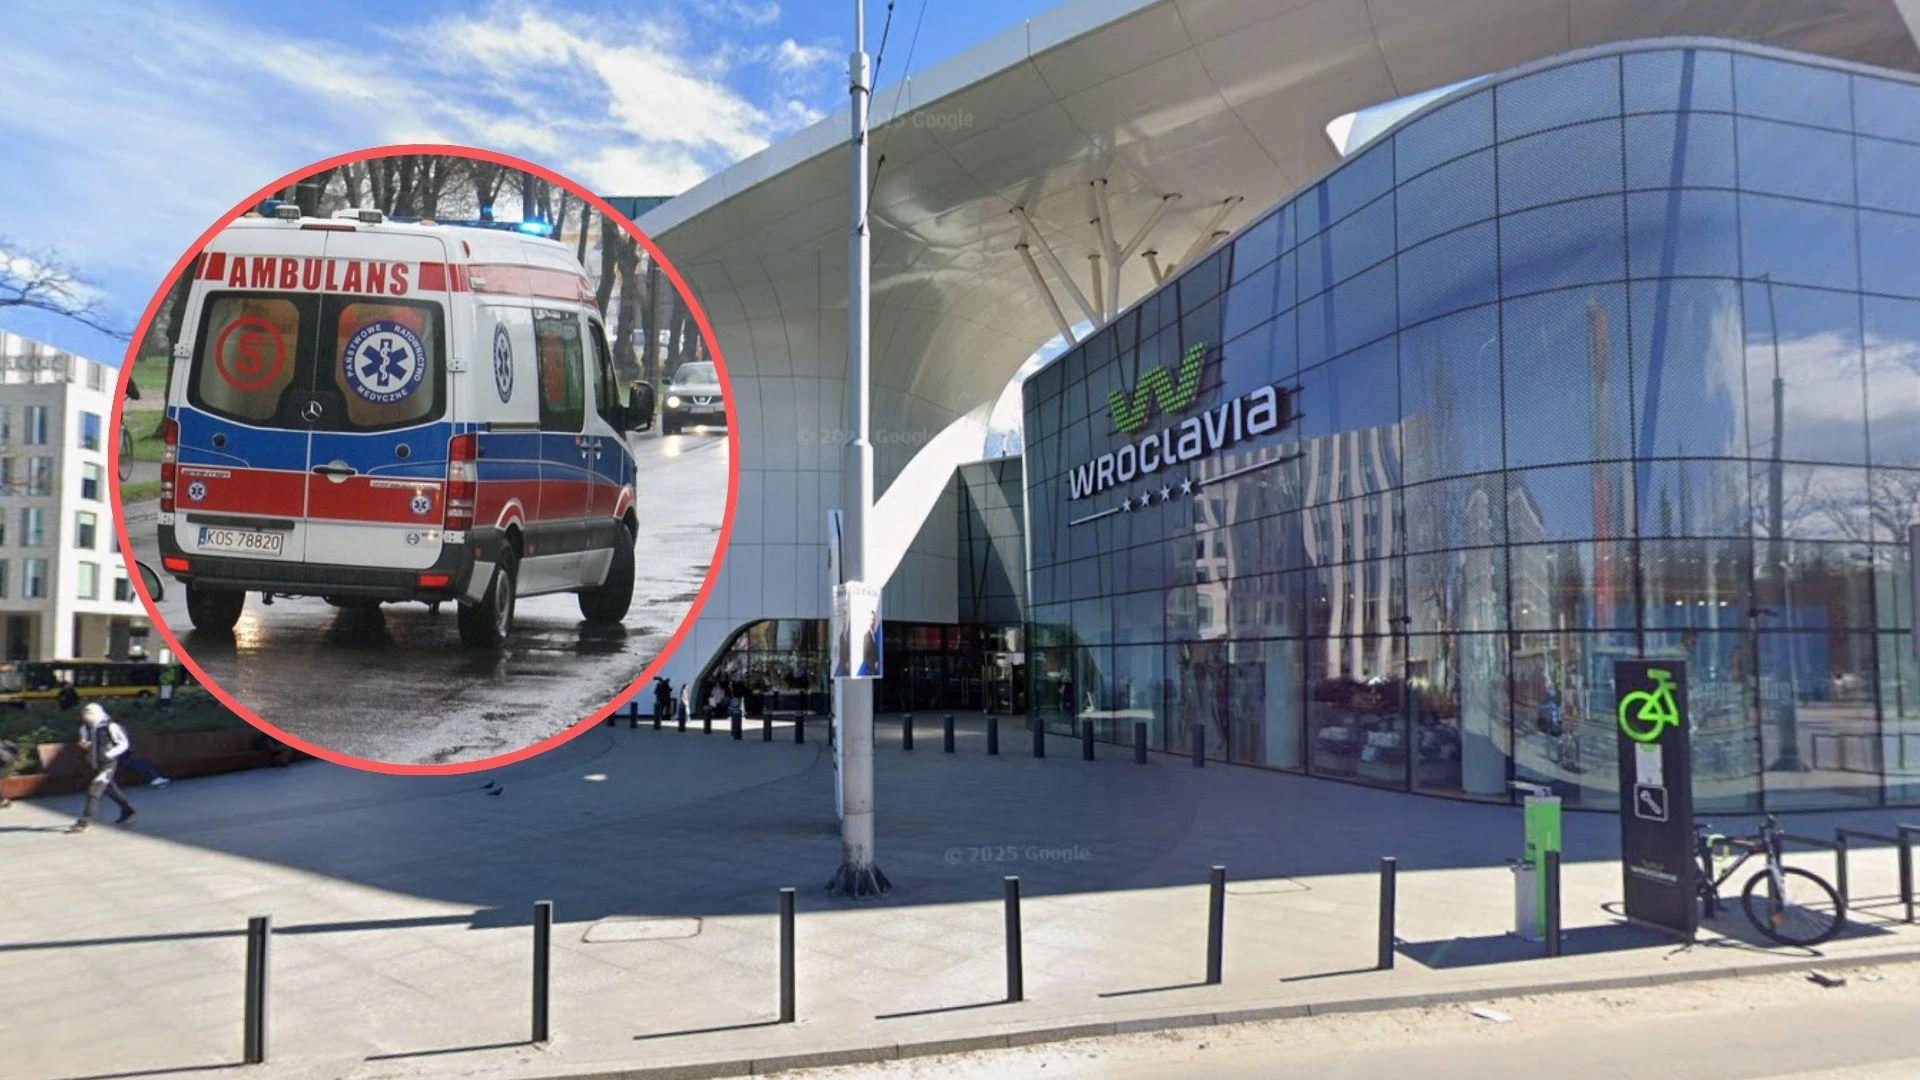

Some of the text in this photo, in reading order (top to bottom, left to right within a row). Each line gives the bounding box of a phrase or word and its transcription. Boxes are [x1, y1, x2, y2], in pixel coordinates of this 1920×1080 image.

[228, 256, 409, 295] AMBULANS
[393, 325, 425, 382] RATOWNICTWO
[357, 385, 408, 402] MEDYCZNE
[207, 531, 280, 550] KOS 78820
